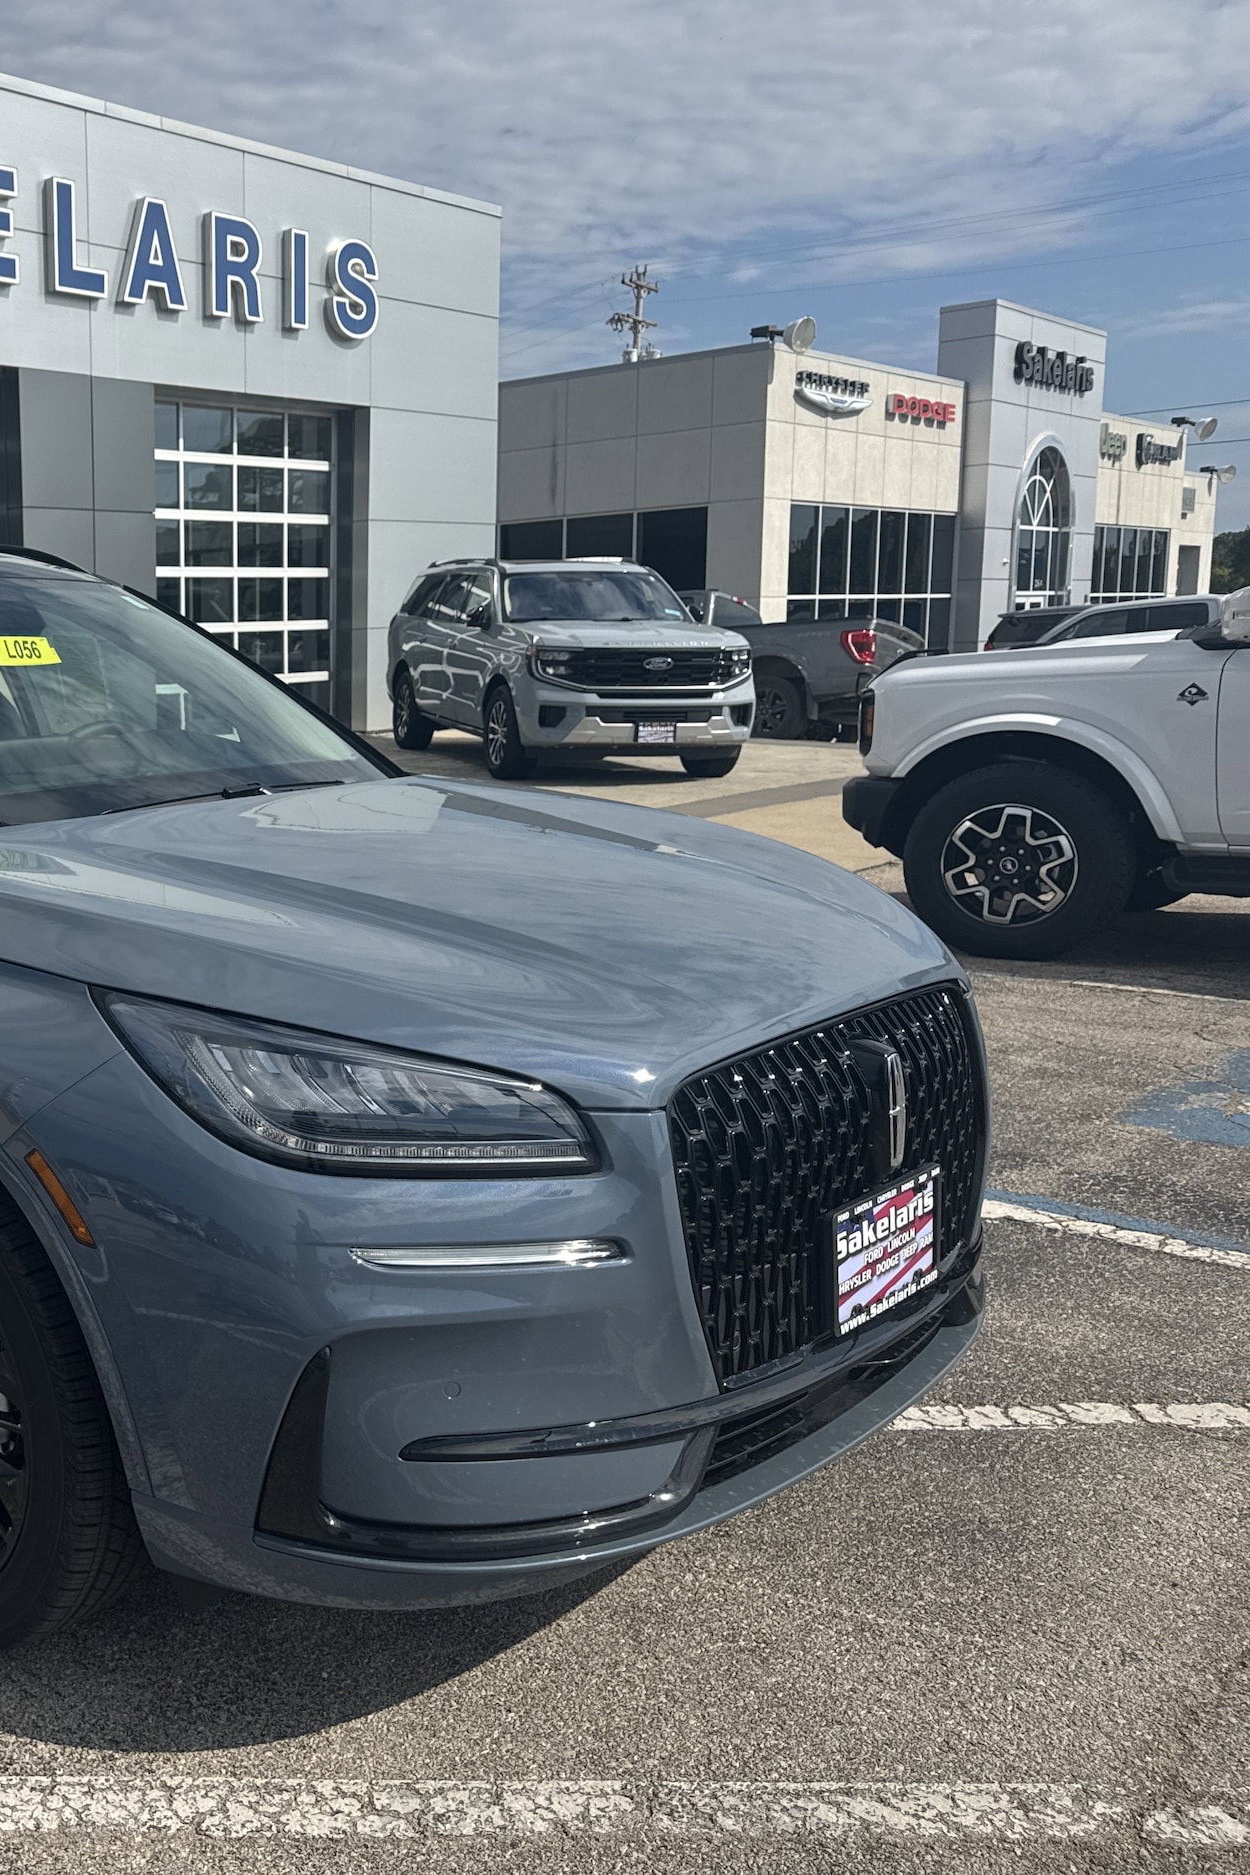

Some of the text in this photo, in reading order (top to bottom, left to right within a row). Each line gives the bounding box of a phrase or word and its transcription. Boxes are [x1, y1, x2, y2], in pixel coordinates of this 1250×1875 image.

[798, 370, 870, 394] CHRYSLER
[1016, 341, 1094, 392] Sakelaris
[891, 393, 956, 422] DODGE
[1101, 423, 1127, 458] Jeep
[3, 640, 42, 659] L056
[837, 1211, 850, 1223] FORD
[853, 1200, 873, 1215] LINCOLN
[876, 1188, 897, 1204] CHRYSLER
[901, 1179, 915, 1192] DODGE
[837, 1191, 934, 1260] Sakelaris
[864, 1227, 915, 1265] FORD LINCOLN
[838, 1268, 872, 1296] HRYSLER
[876, 1252, 899, 1276] DODGE
[840, 1269, 938, 1336] www.Sakelaris.com
